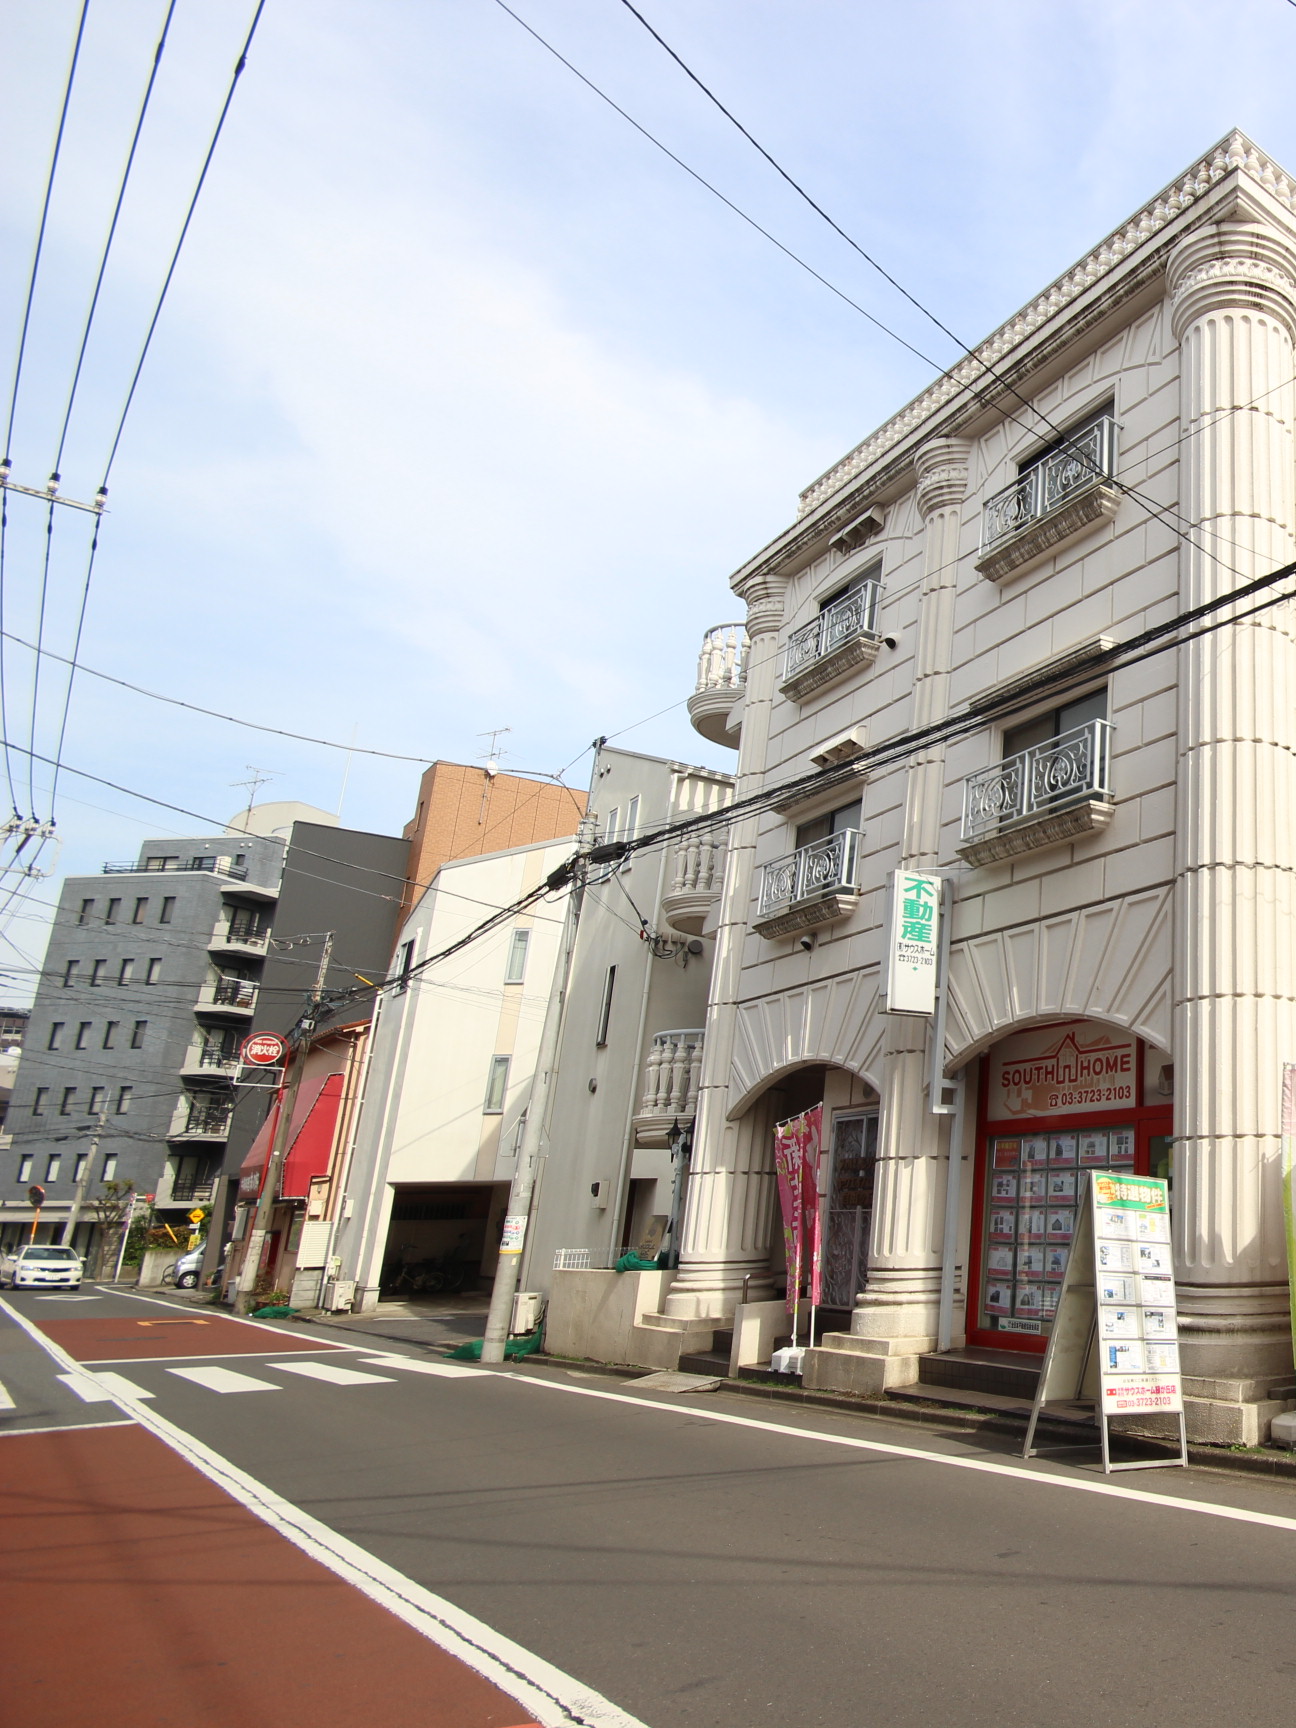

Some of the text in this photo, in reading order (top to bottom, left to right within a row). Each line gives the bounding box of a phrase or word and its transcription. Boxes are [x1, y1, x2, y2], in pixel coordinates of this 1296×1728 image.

[901, 877, 935, 943] 不動産
[250, 1044, 280, 1057] 消火栓
[1001, 1053, 1132, 1088] SOUTH HOME
[1061, 1085, 1132, 1106] 03-3723-2103
